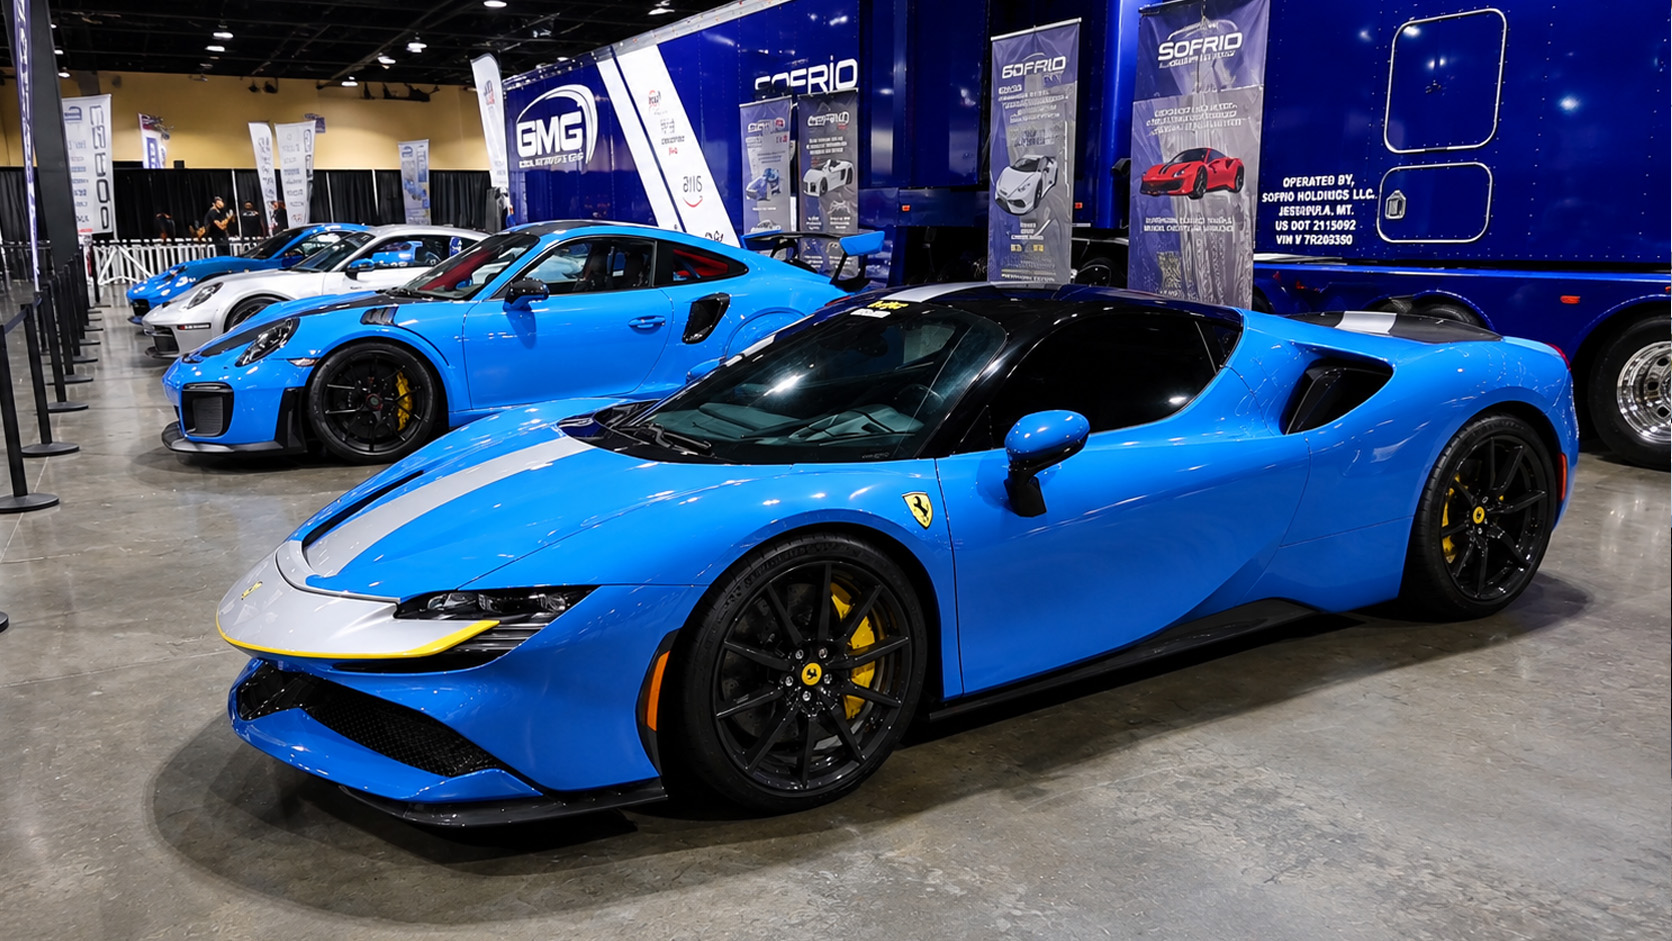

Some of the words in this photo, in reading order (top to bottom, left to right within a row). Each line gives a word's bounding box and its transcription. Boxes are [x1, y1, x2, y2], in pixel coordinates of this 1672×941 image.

[516, 110, 583, 158] GMG
[1275, 220, 1289, 231] US
[1290, 220, 1311, 231] DOT
[1313, 219, 1356, 231] 2115092
